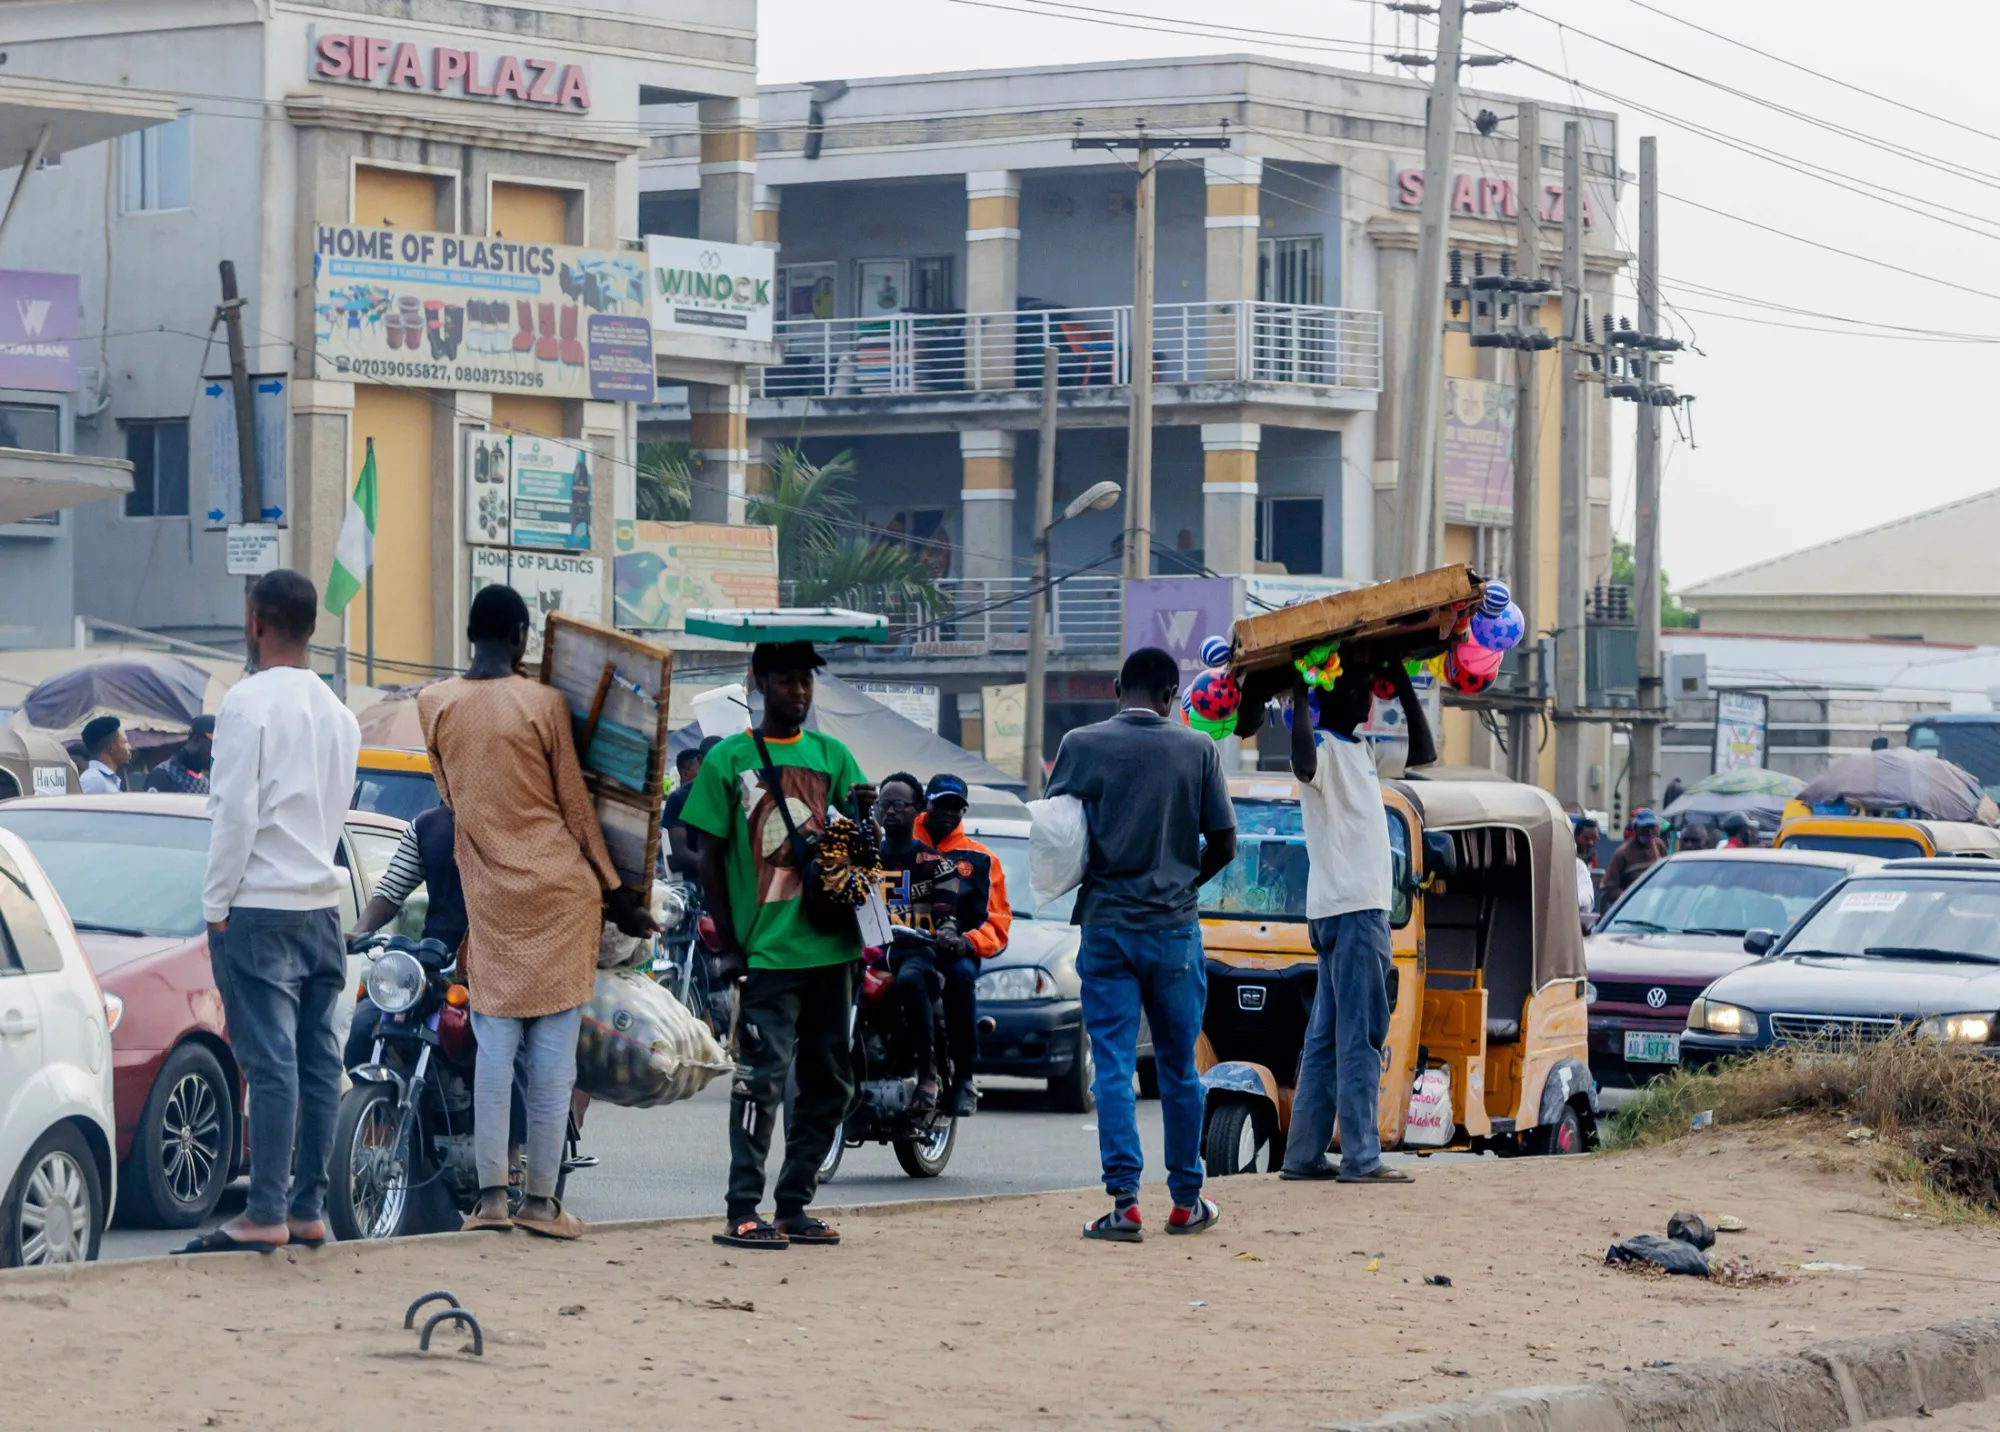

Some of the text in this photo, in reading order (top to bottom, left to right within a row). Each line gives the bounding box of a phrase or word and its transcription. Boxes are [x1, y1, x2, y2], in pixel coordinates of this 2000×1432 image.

[317, 34, 591, 108] SIFA PLAZA
[1398, 168, 1596, 228] SA PLZA
[319, 226, 555, 276] HOME OF PLASTICS
[655, 267, 771, 306] WINOCK
[36, 344, 70, 357] BANK
[478, 551, 594, 574] HOME OF PLASTICS
